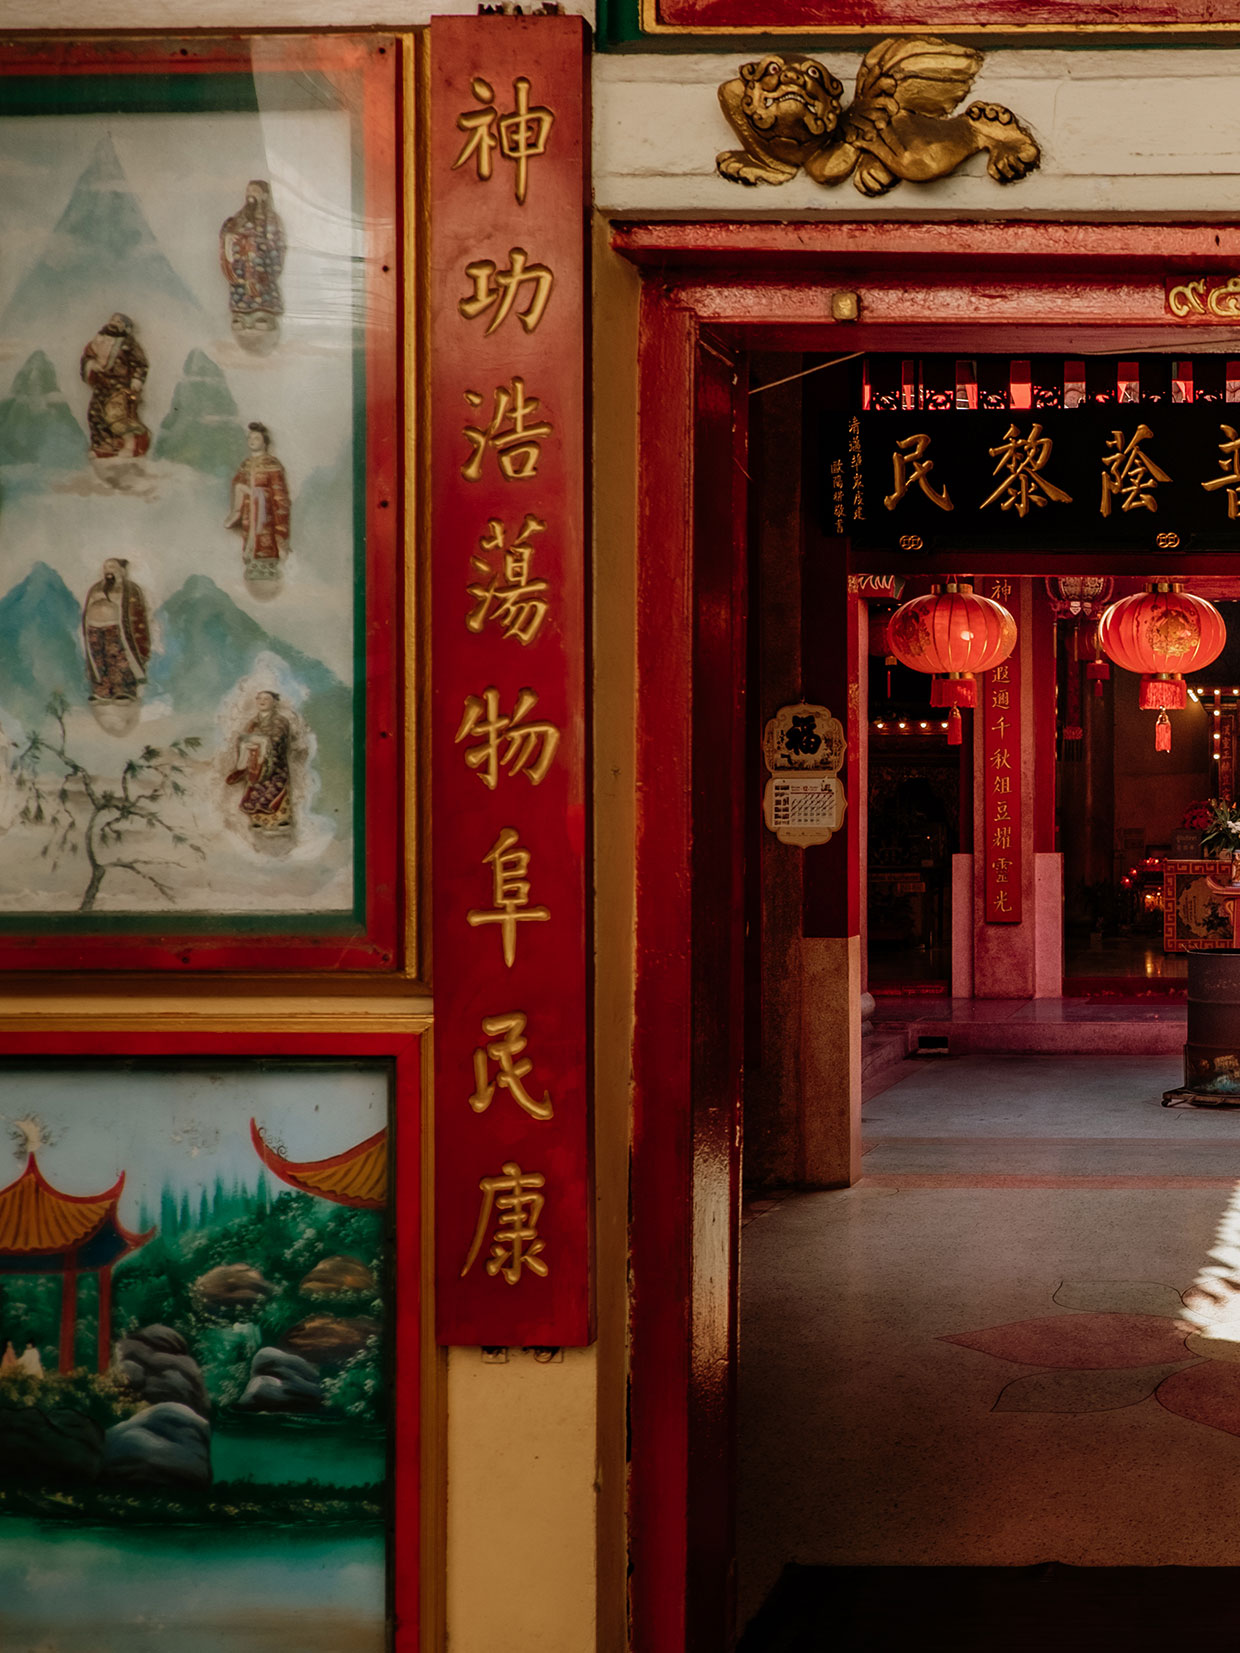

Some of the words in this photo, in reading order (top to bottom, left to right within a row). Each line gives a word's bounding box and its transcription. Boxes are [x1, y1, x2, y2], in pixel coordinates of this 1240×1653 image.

[453, 77, 560, 1284] 神功浩蕩物阜民康
